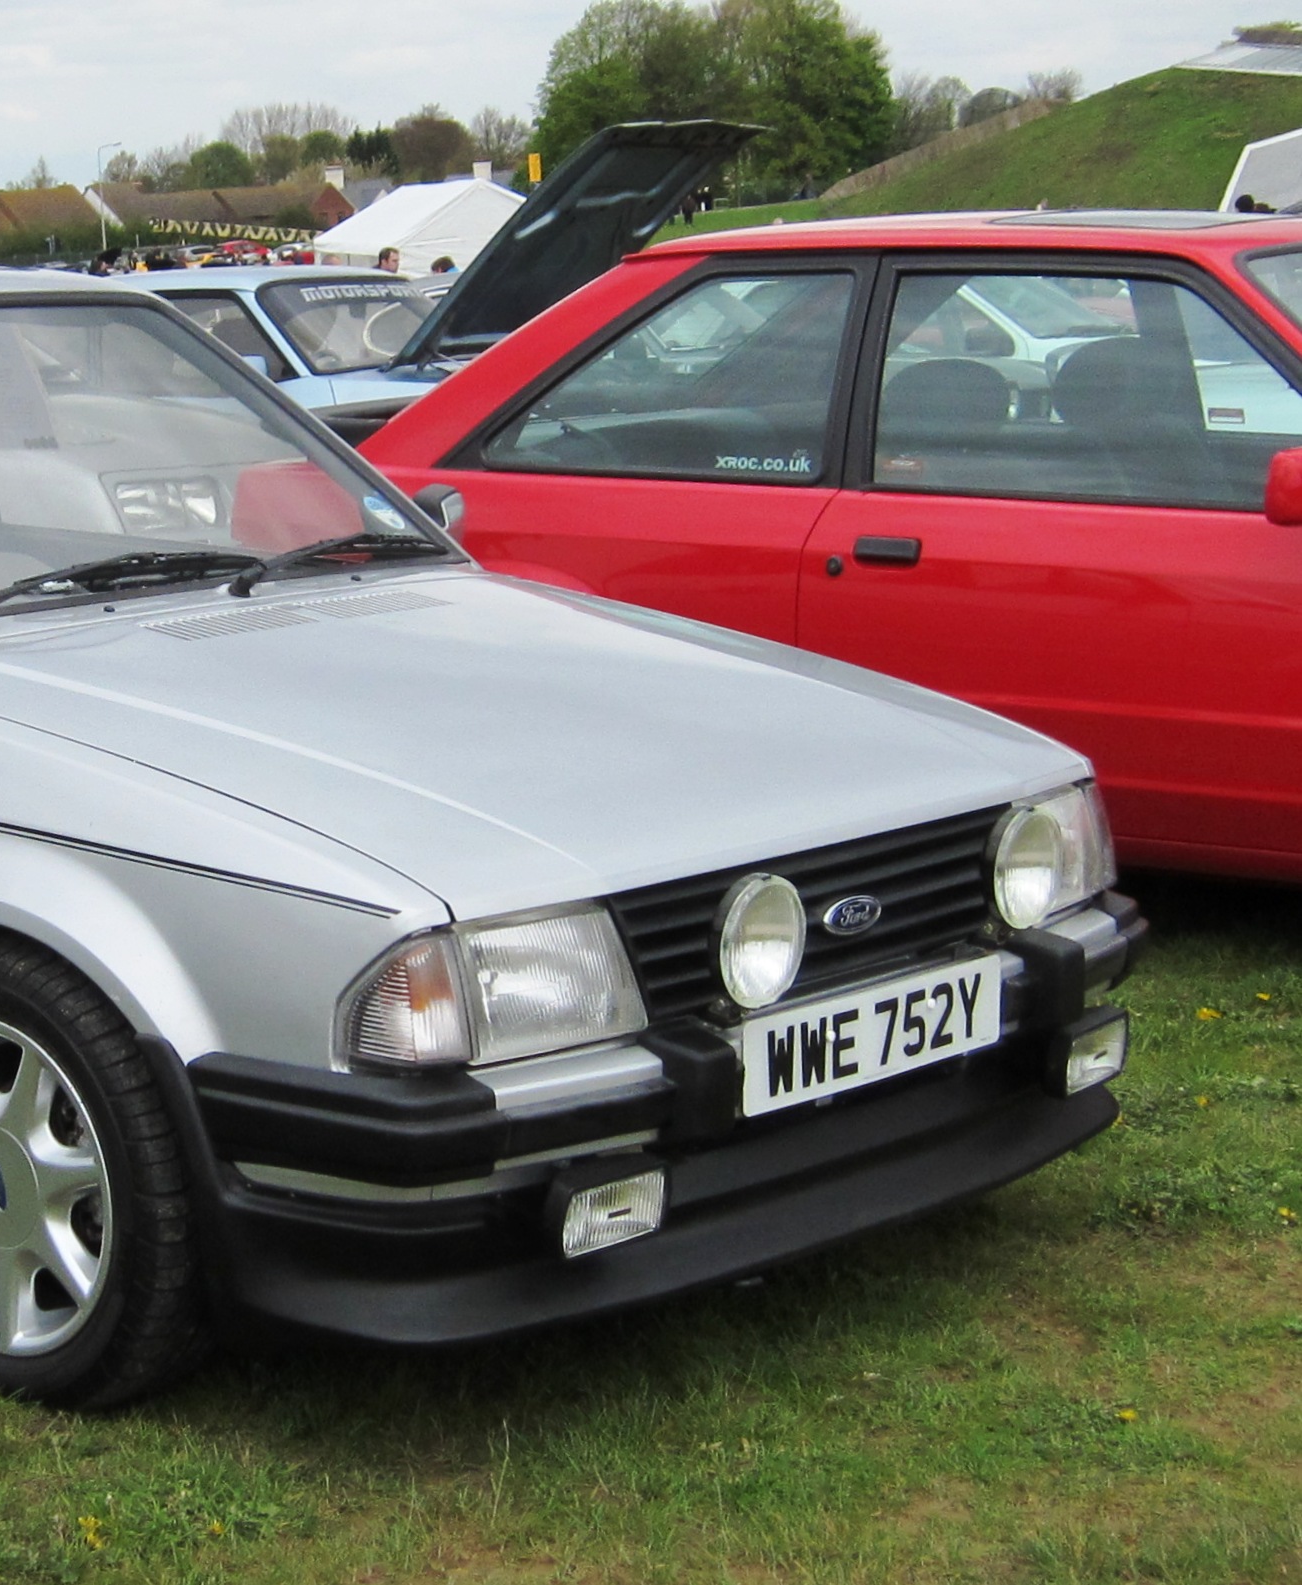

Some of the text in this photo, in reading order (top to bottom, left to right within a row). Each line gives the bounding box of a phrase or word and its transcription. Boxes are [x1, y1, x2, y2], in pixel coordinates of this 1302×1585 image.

[299, 284, 422, 302] MOTORSPORT
[840, 903, 870, 927] Ford
[767, 973, 982, 1098] WWE 752Y
